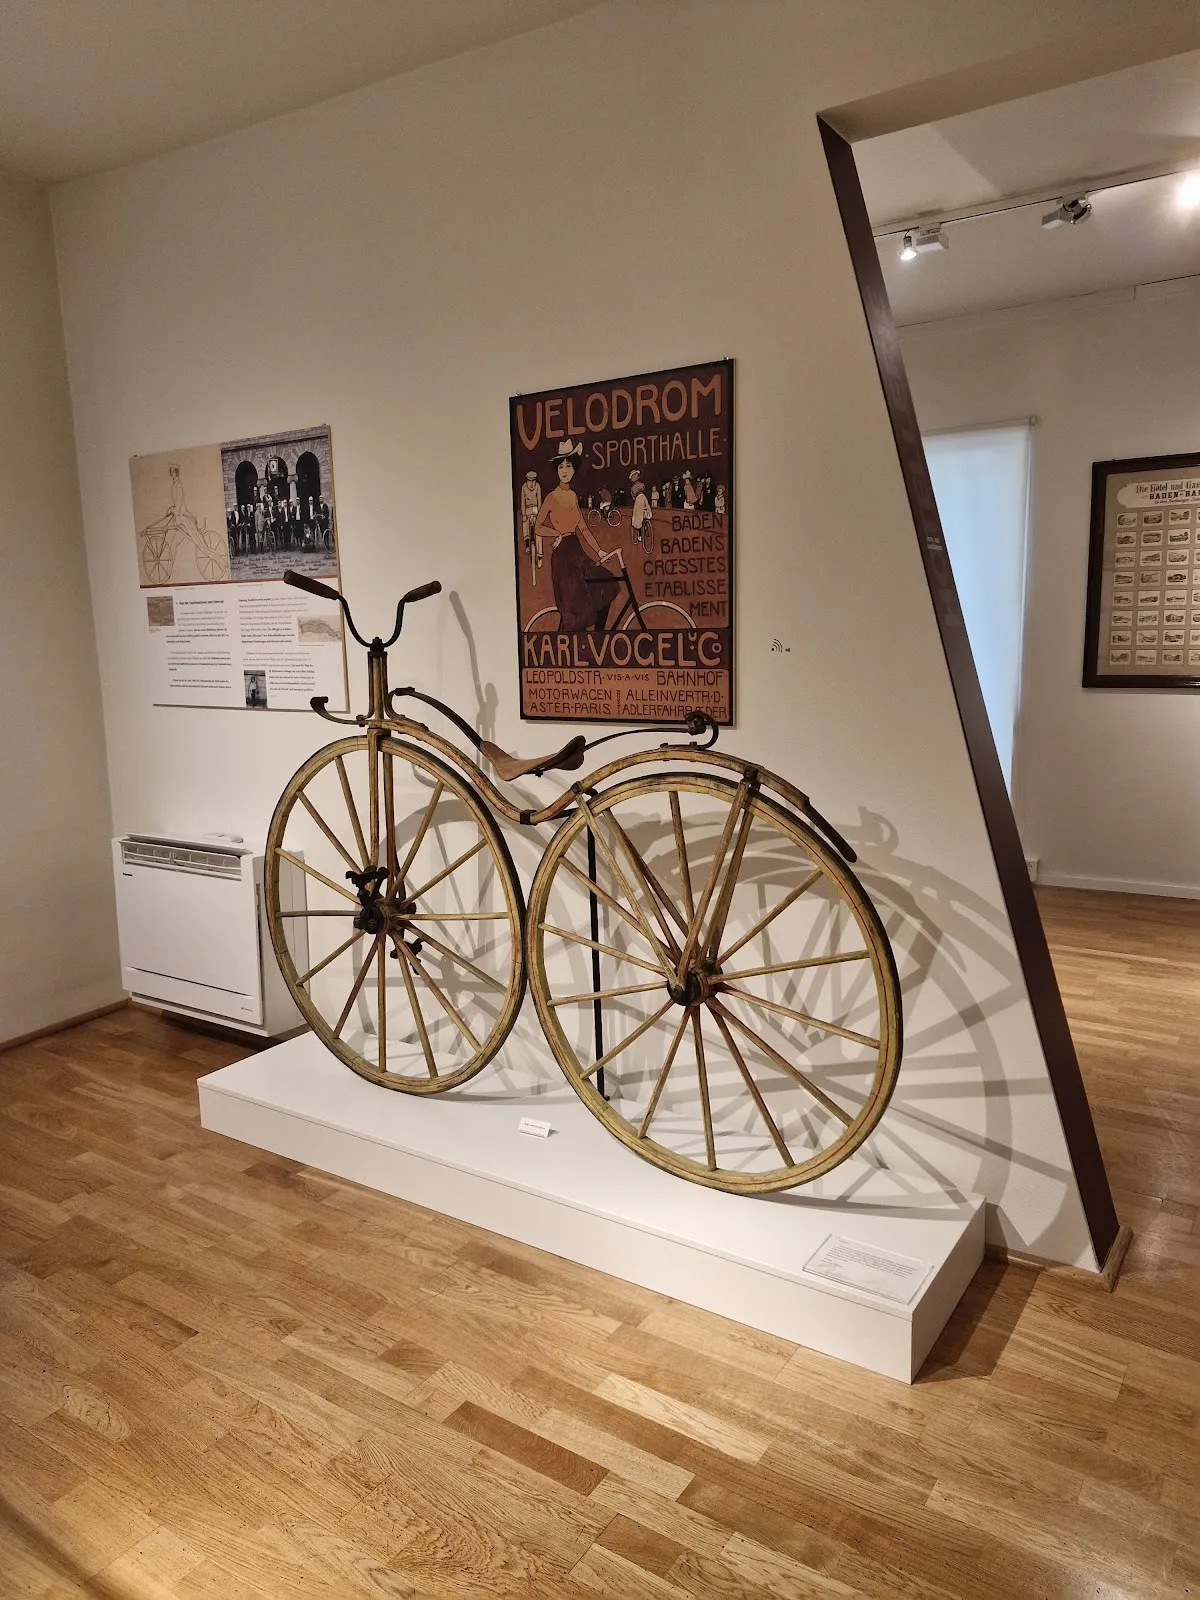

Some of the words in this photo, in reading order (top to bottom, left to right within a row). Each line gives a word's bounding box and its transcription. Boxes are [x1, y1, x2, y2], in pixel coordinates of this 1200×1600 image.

[517, 374, 721, 450] VELODROM
[591, 427, 723, 470] SPORTHALLE
[672, 513, 724, 532] BADEN
[661, 534, 725, 554] BADENS
[644, 578, 727, 598] ETABLISSE
[689, 600, 727, 617] MENT
[523, 633, 589, 667] KARL
[587, 632, 697, 667] VOGEL
[656, 670, 724, 686] BAHNHOF
